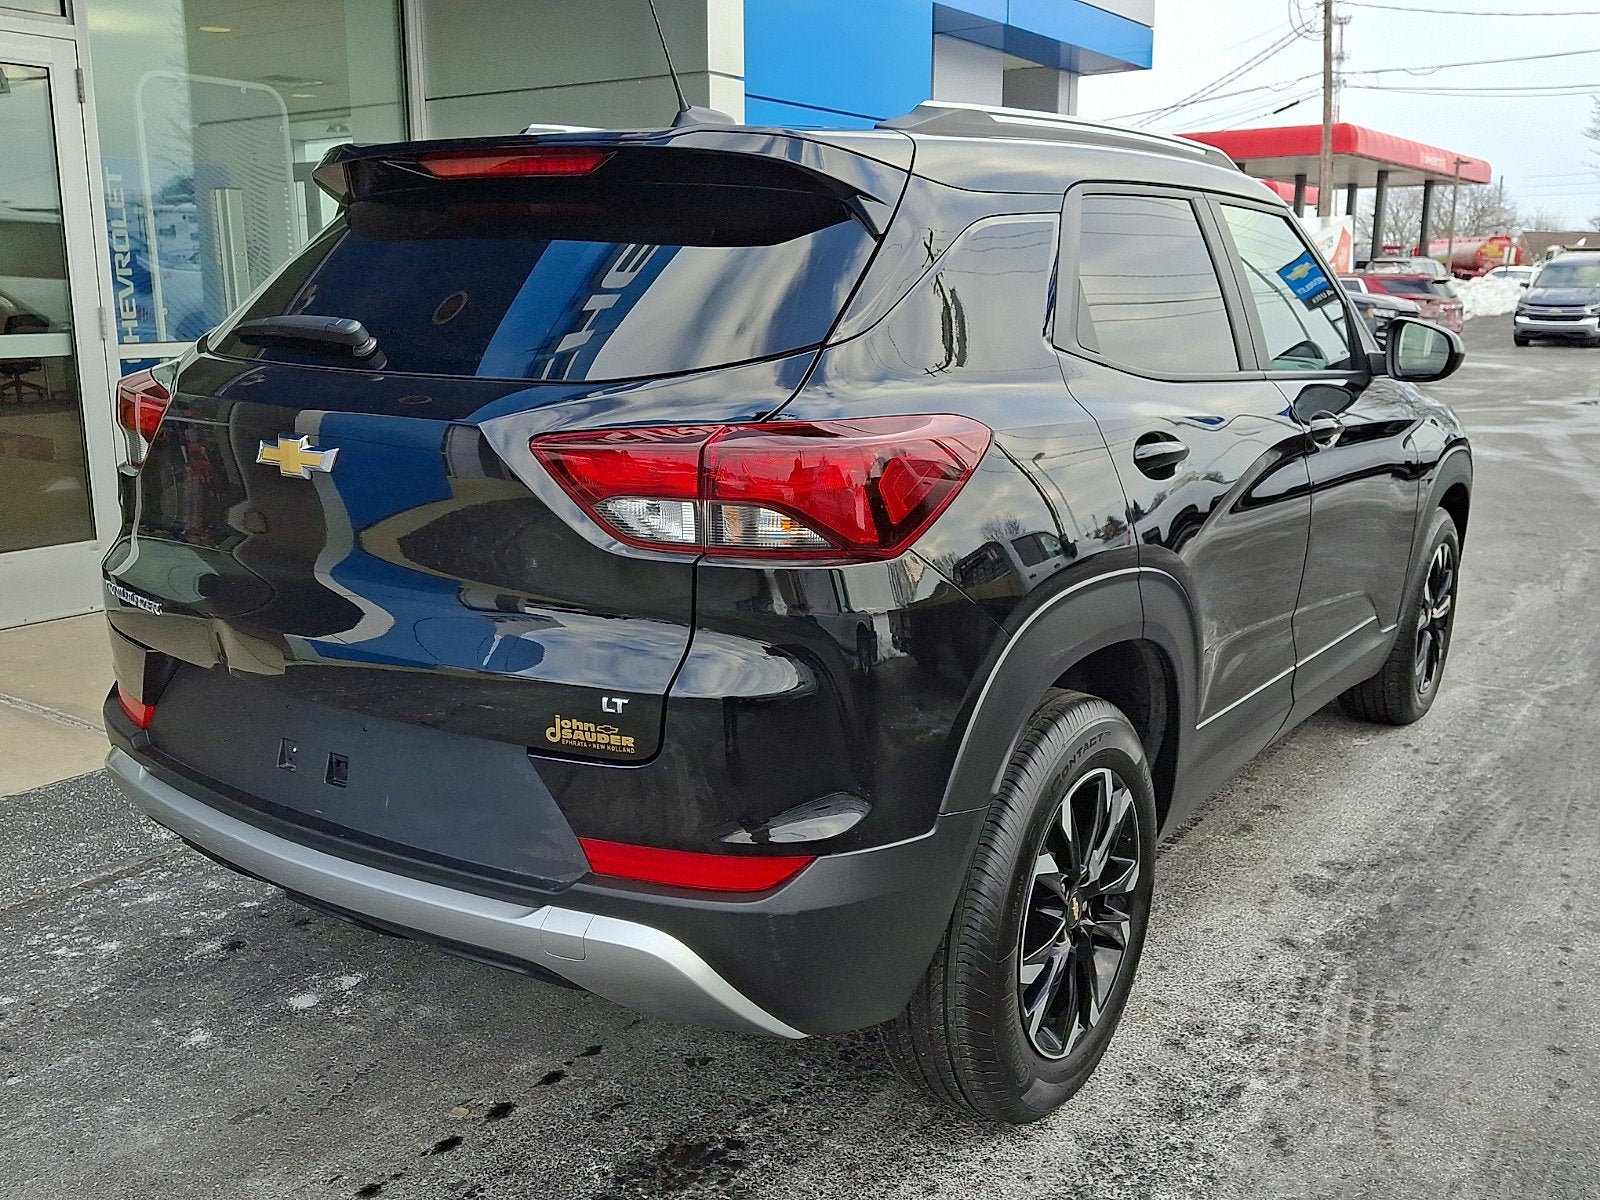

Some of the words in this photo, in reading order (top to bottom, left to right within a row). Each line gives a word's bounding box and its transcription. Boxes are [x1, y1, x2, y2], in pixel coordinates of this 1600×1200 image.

[105, 166, 142, 364] HEVROLET
[601, 696, 630, 714] LT
[561, 728, 635, 748] SAUDER
[561, 738, 588, 748] EPHRATA
[606, 744, 636, 754] HOLLAND
